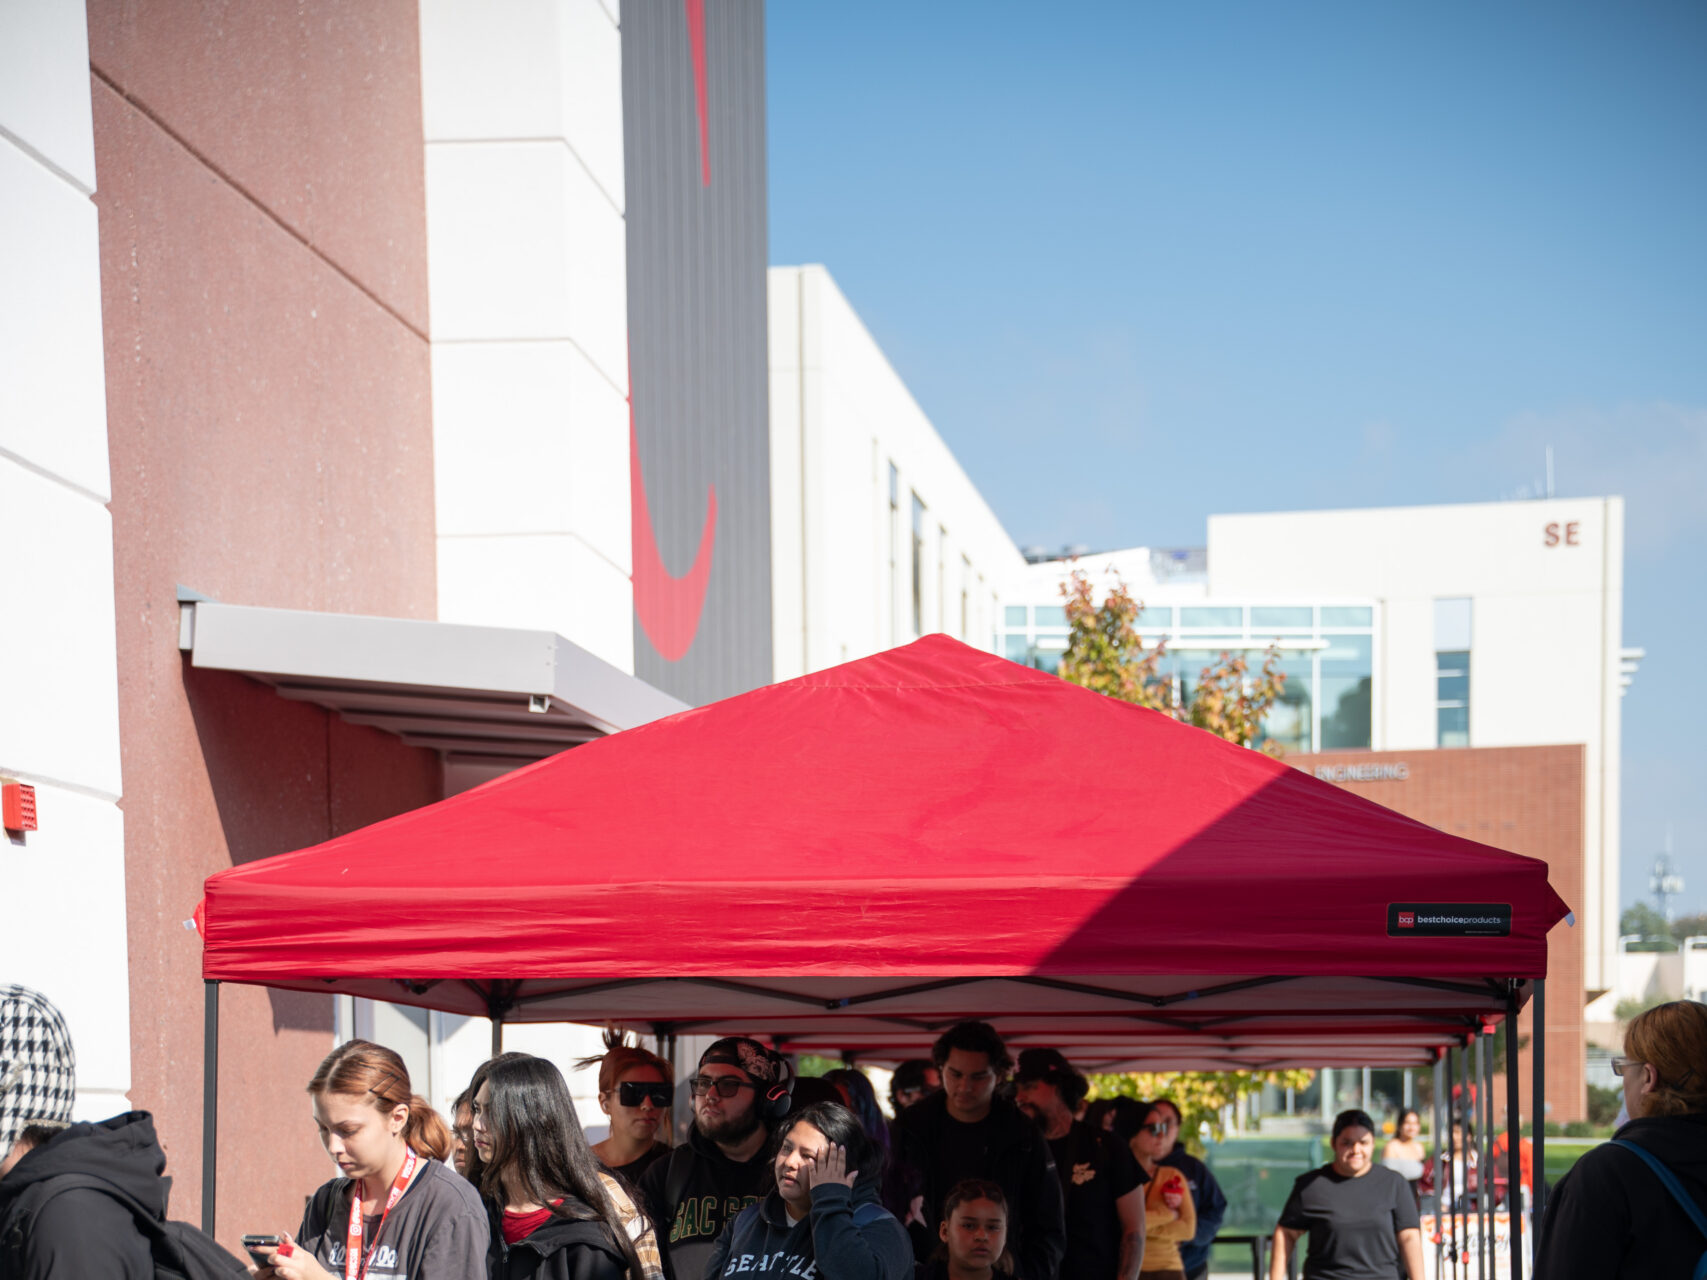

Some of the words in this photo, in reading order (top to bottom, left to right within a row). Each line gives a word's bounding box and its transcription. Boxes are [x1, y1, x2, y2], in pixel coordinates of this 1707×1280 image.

[1544, 521, 1581, 548] SE
[1398, 915, 1414, 925] bcp
[1417, 915, 1501, 925] bestchoiceproducts
[669, 1195, 718, 1244] SAC
